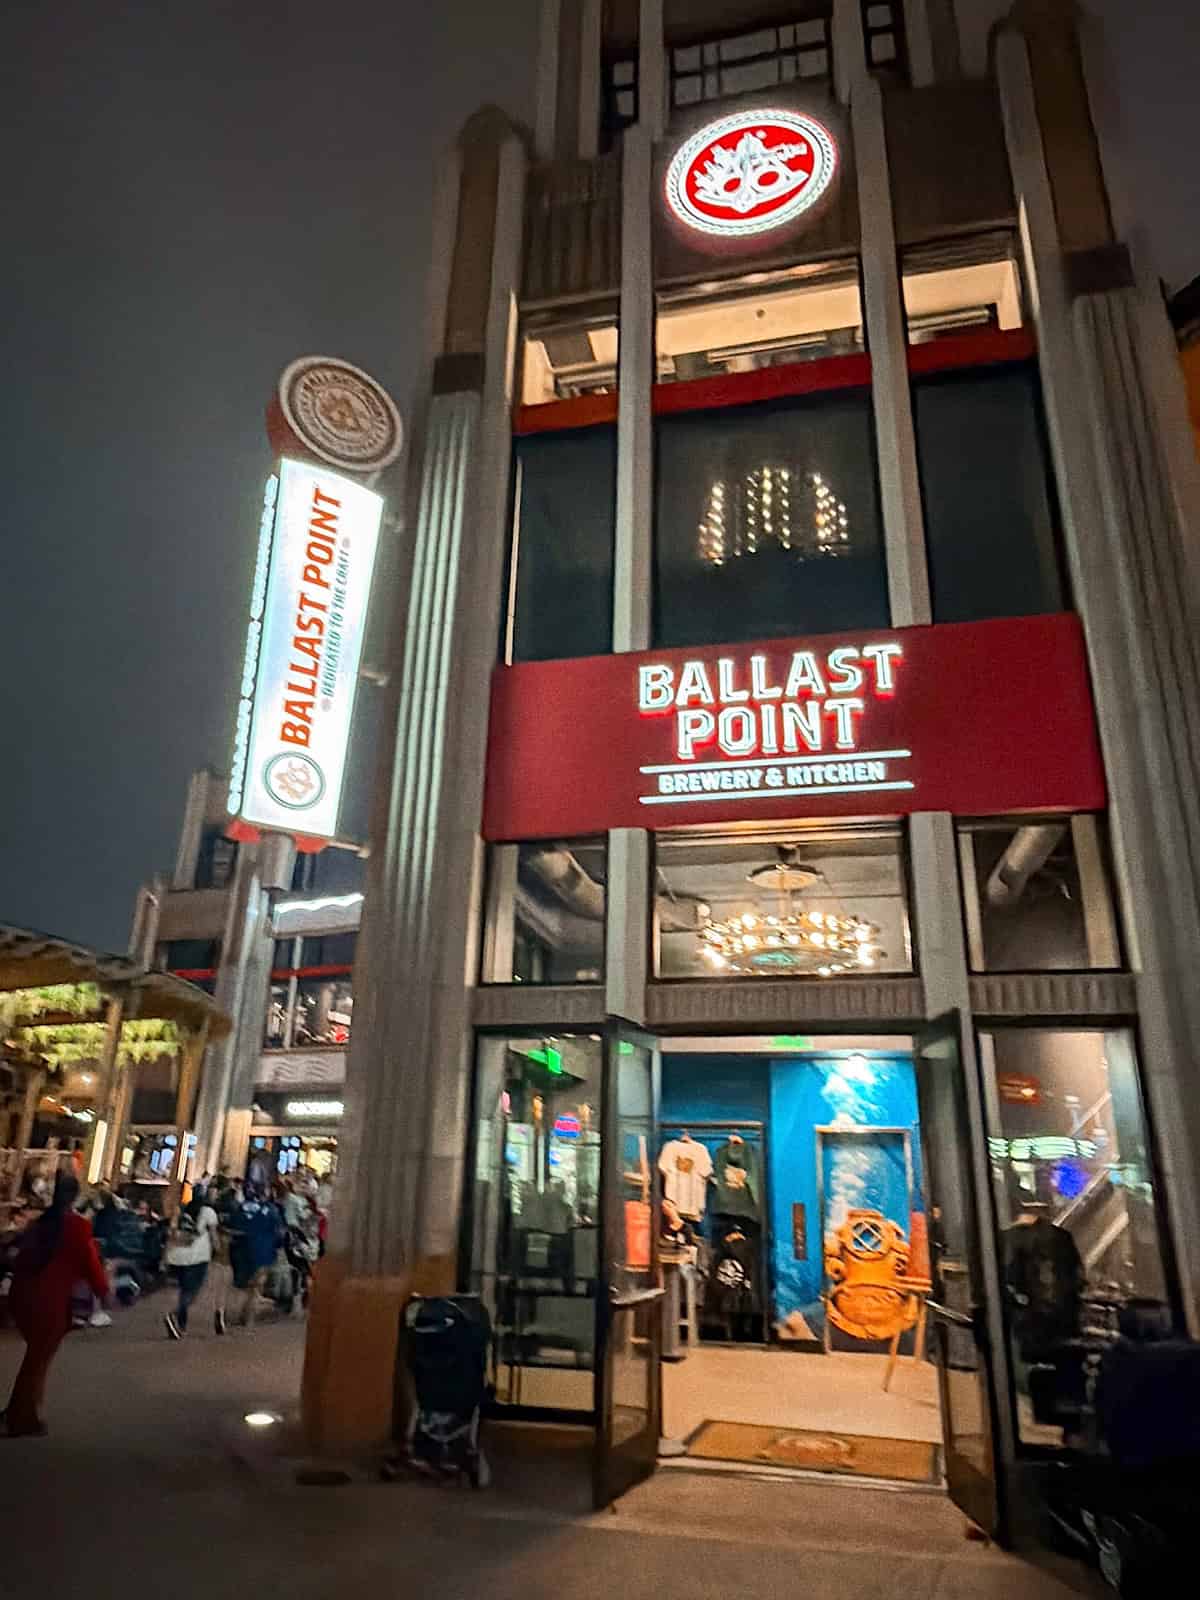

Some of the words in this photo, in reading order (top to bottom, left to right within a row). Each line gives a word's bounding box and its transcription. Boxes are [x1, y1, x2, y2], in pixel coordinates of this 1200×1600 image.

[302, 487, 342, 589] POINT
[328, 611, 344, 628] TO
[332, 586, 346, 610] THE
[281, 591, 329, 748] BALLAST
[320, 629, 342, 697] DEDICATED
[638, 643, 902, 709] BALLAST
[676, 697, 864, 759] POINT
[658, 769, 763, 793] BREWERY
[765, 766, 784, 787] &
[787, 761, 885, 785] KITCHEN
